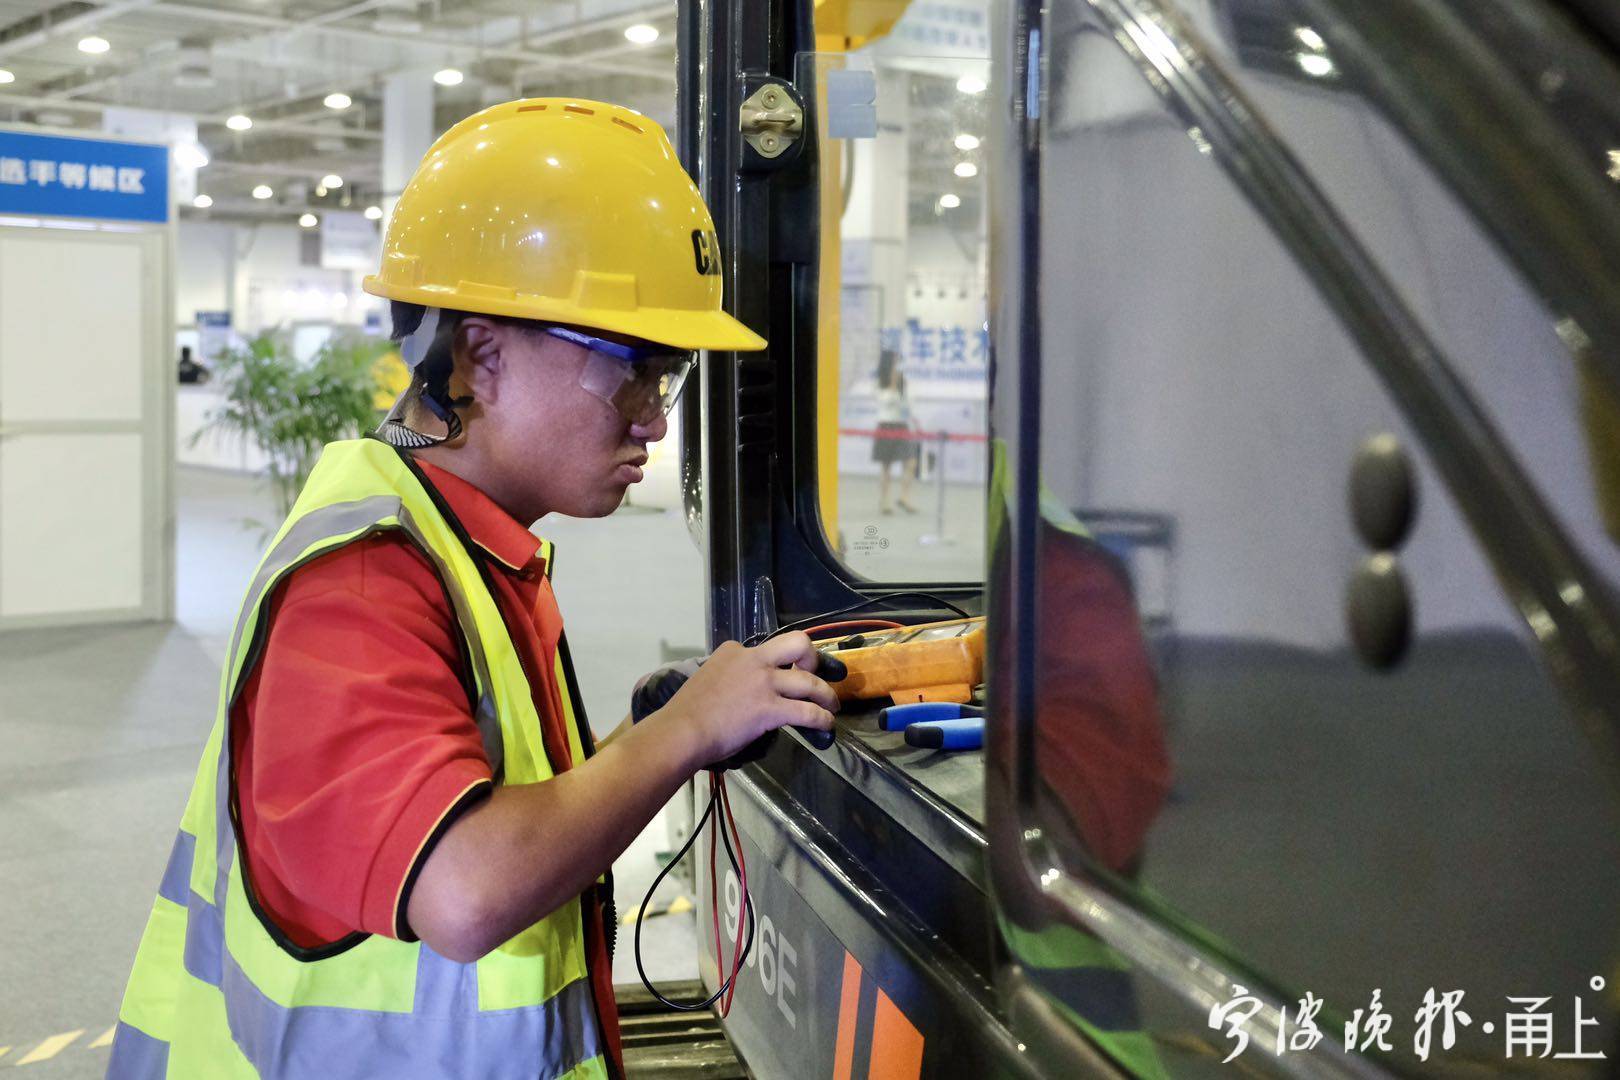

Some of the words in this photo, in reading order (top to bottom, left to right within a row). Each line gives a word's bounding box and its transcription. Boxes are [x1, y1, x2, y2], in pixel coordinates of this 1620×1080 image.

[0, 157, 145, 194] 选手等候区
[724, 869, 798, 1031] 906E
